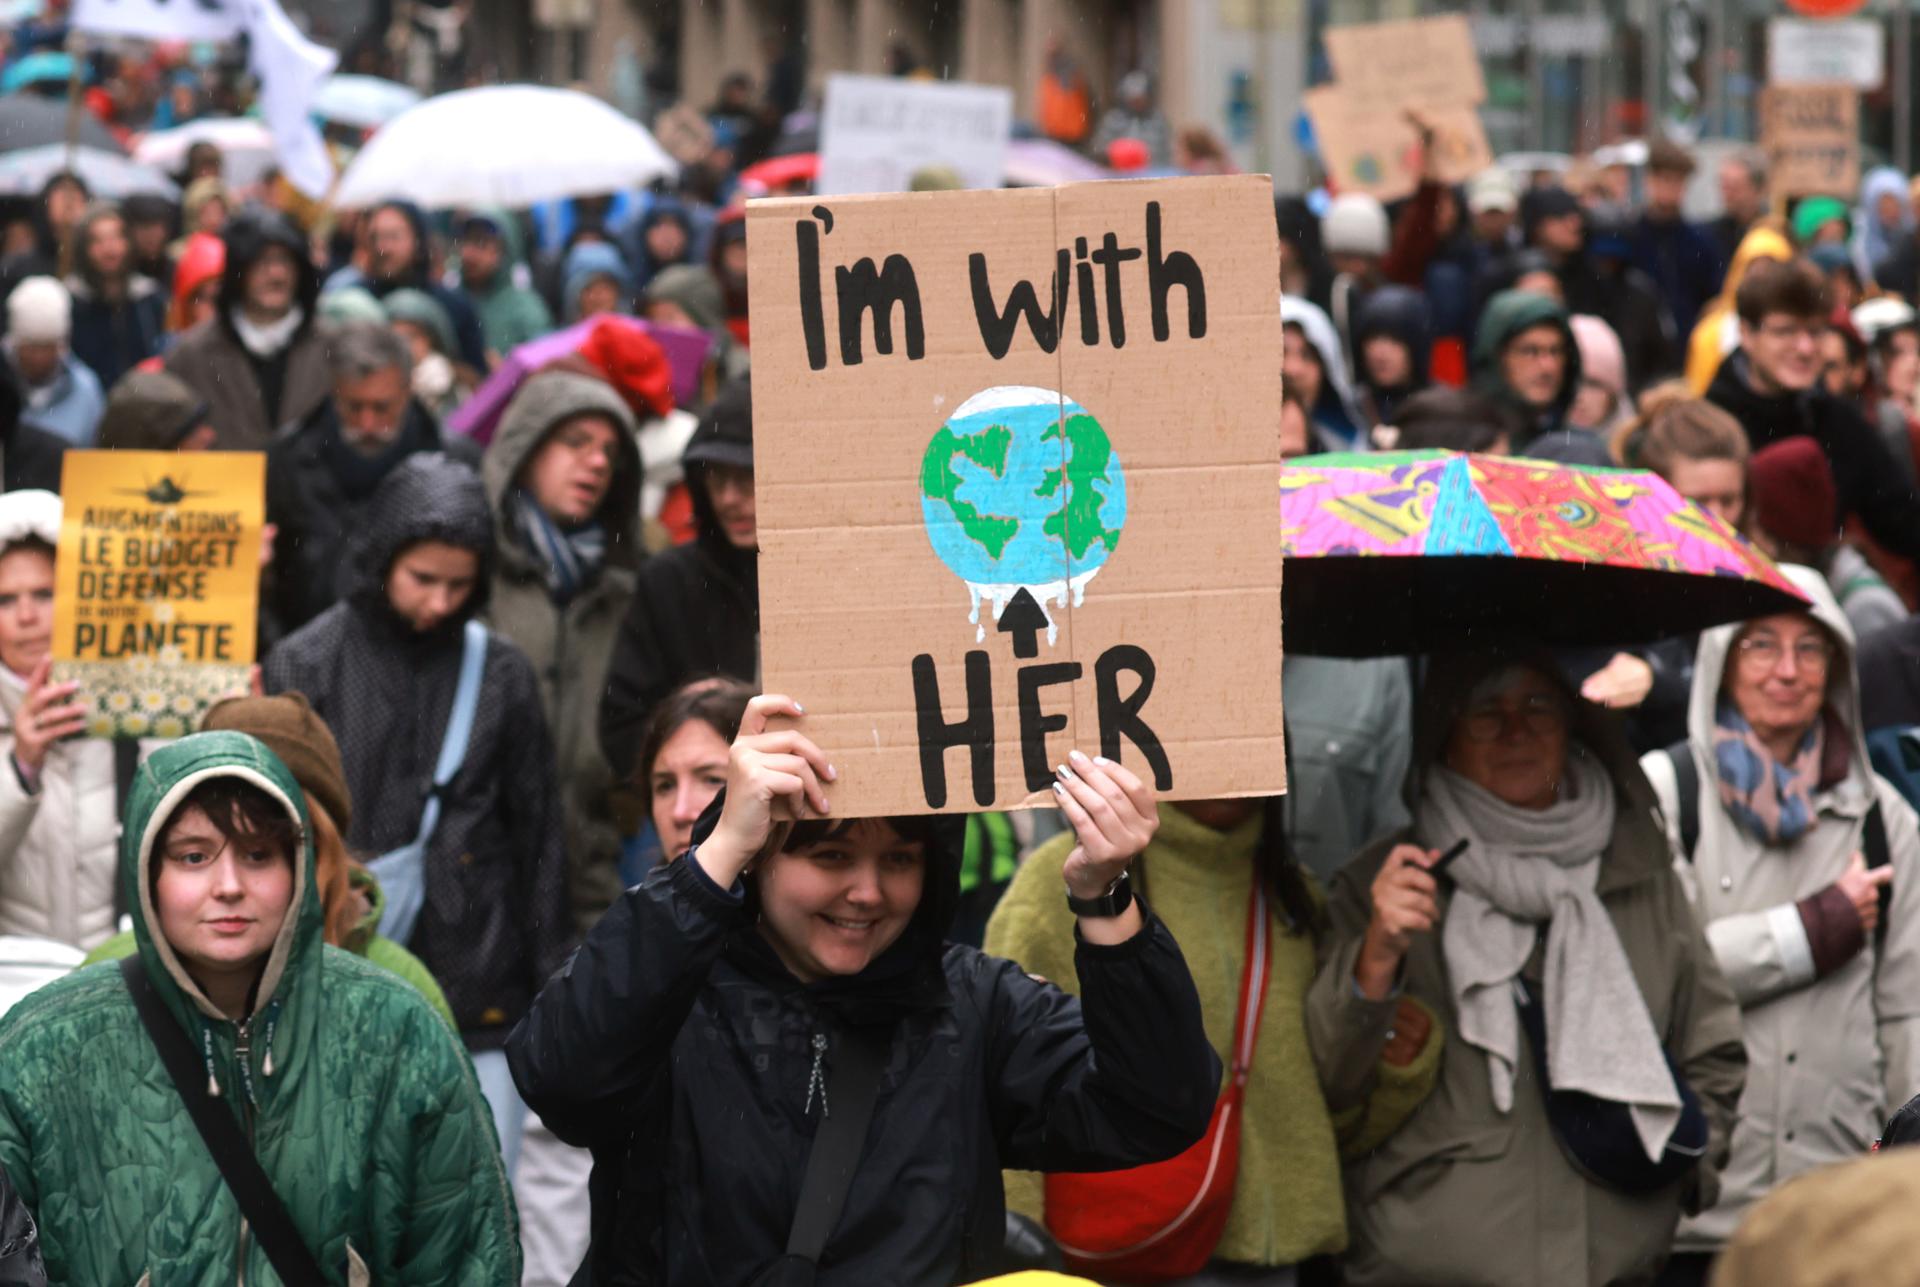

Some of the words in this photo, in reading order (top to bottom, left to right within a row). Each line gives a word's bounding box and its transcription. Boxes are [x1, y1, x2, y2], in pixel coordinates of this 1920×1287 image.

[796, 205, 925, 370] I'm
[968, 201, 1207, 360] with
[79, 535, 112, 567] LE
[124, 538, 239, 568] BUDGET
[911, 644, 1173, 810] HER
